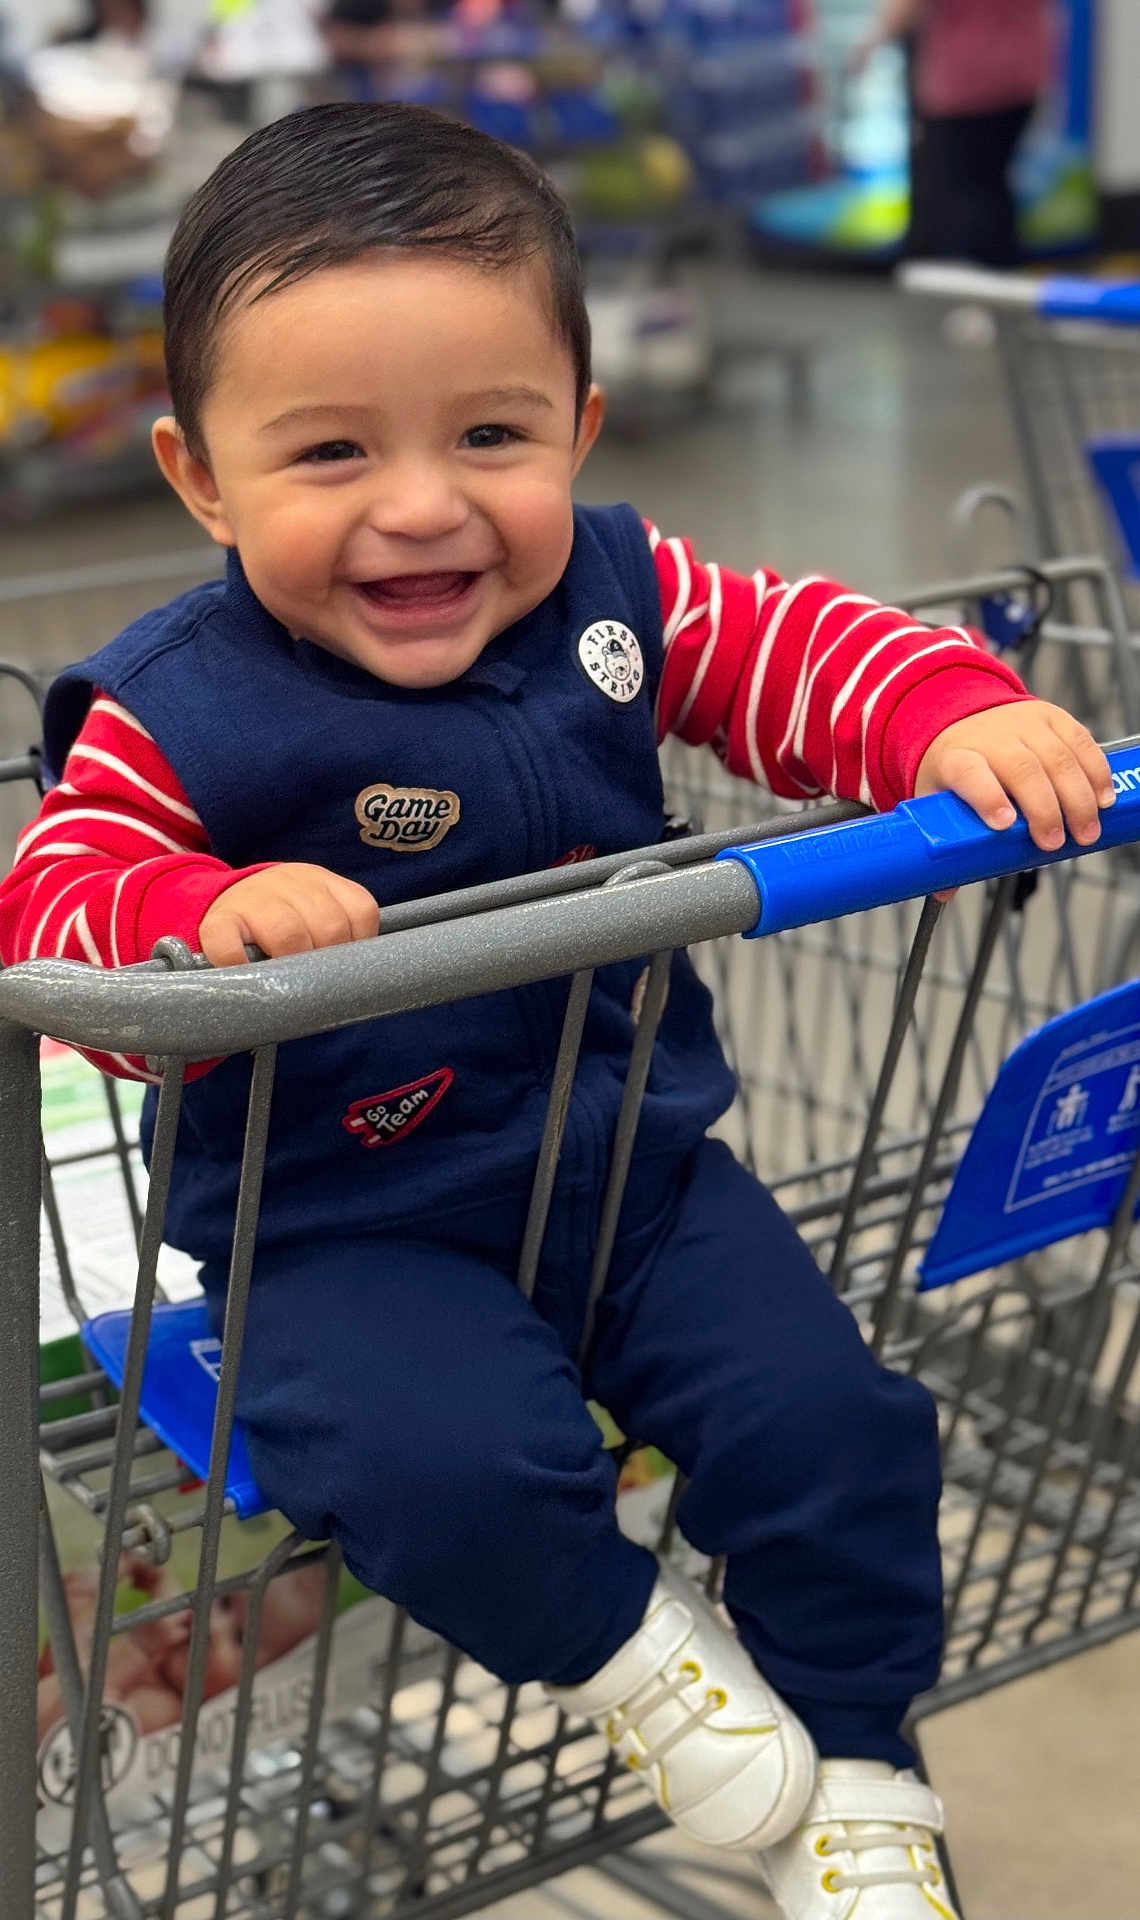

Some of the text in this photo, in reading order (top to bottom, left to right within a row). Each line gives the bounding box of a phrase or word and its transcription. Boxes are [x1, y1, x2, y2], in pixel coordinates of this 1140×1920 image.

[587, 624, 636, 649] FIRST
[589, 662, 640, 697] STRING
[363, 793, 451, 822] Game
[369, 820, 441, 844] Day
[366, 1105, 387, 1122] Go
[376, 1089, 429, 1133] Team
